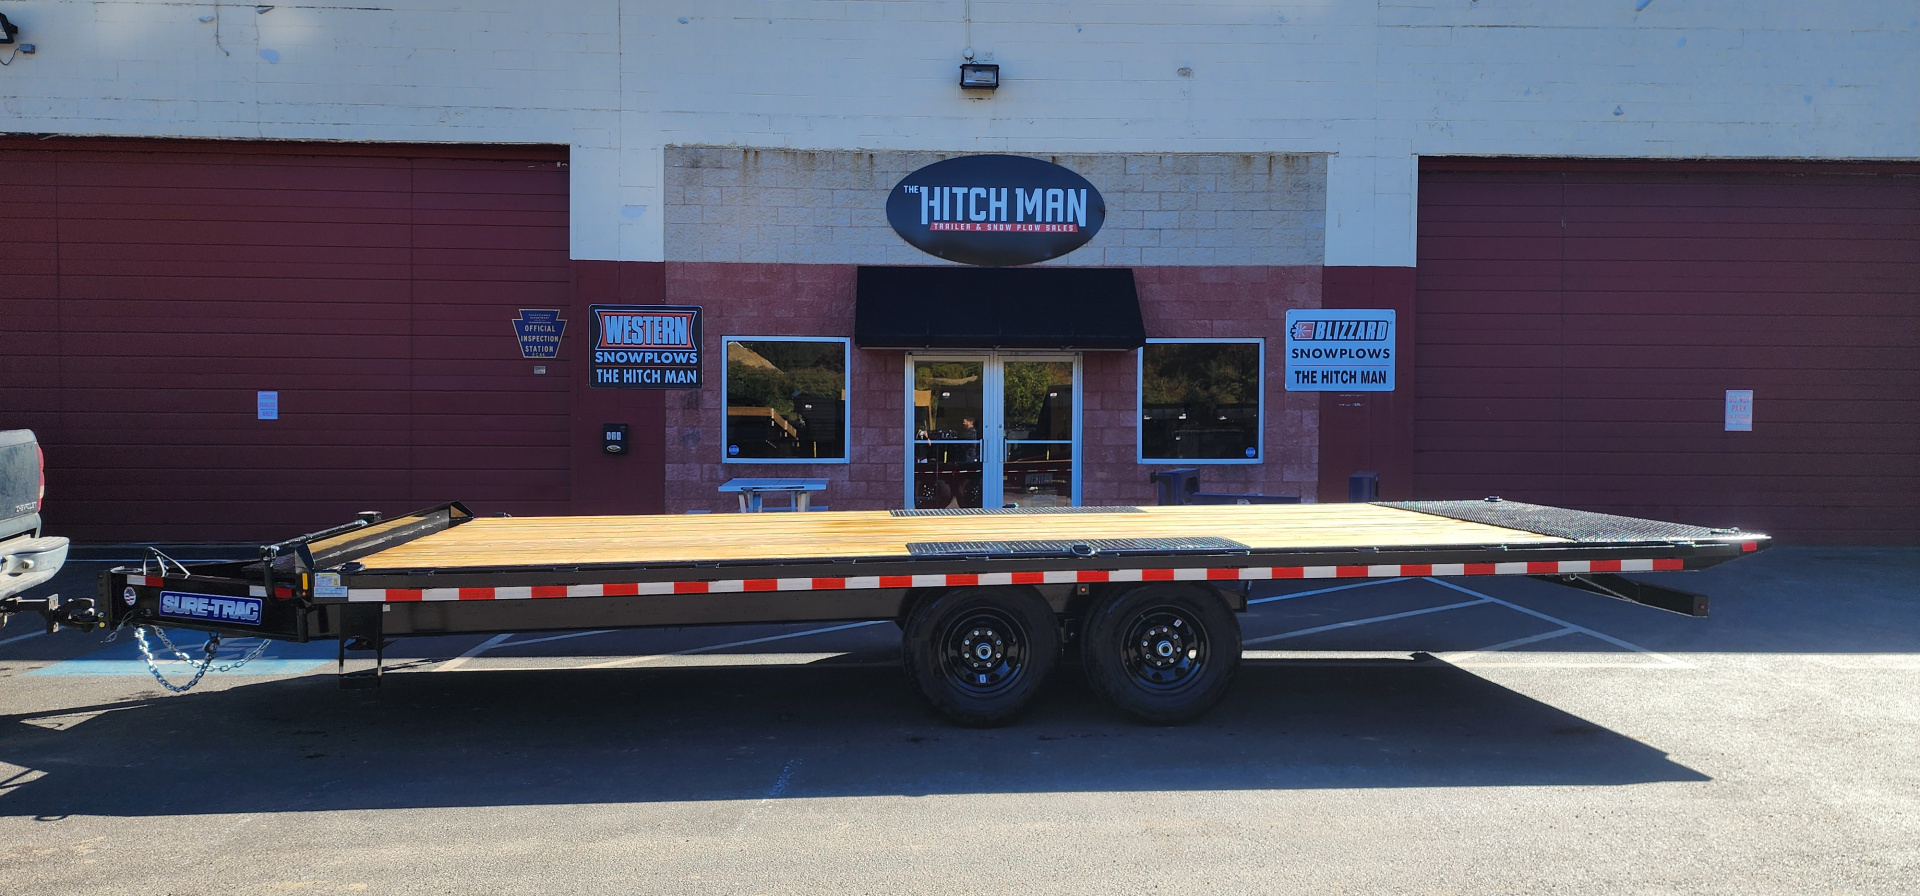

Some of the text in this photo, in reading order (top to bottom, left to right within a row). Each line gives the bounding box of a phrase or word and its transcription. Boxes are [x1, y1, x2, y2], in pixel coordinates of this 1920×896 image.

[904, 185, 1087, 227] THE HITCH MAN
[934, 222, 971, 231] TRAILER
[976, 223, 982, 231] &
[987, 223, 1012, 231] SNOW
[1045, 224, 1074, 232] SALES
[604, 315, 687, 345] WESTERN
[1314, 321, 1388, 340] BLIZZARD
[594, 352, 698, 364] SNOWPLOWS
[1291, 348, 1390, 359] SNOWPLOWS
[596, 369, 697, 384] THE HITCH MAN
[1294, 370, 1387, 384] THE HITCH MAN
[162, 595, 259, 621] SURE-TRAC
